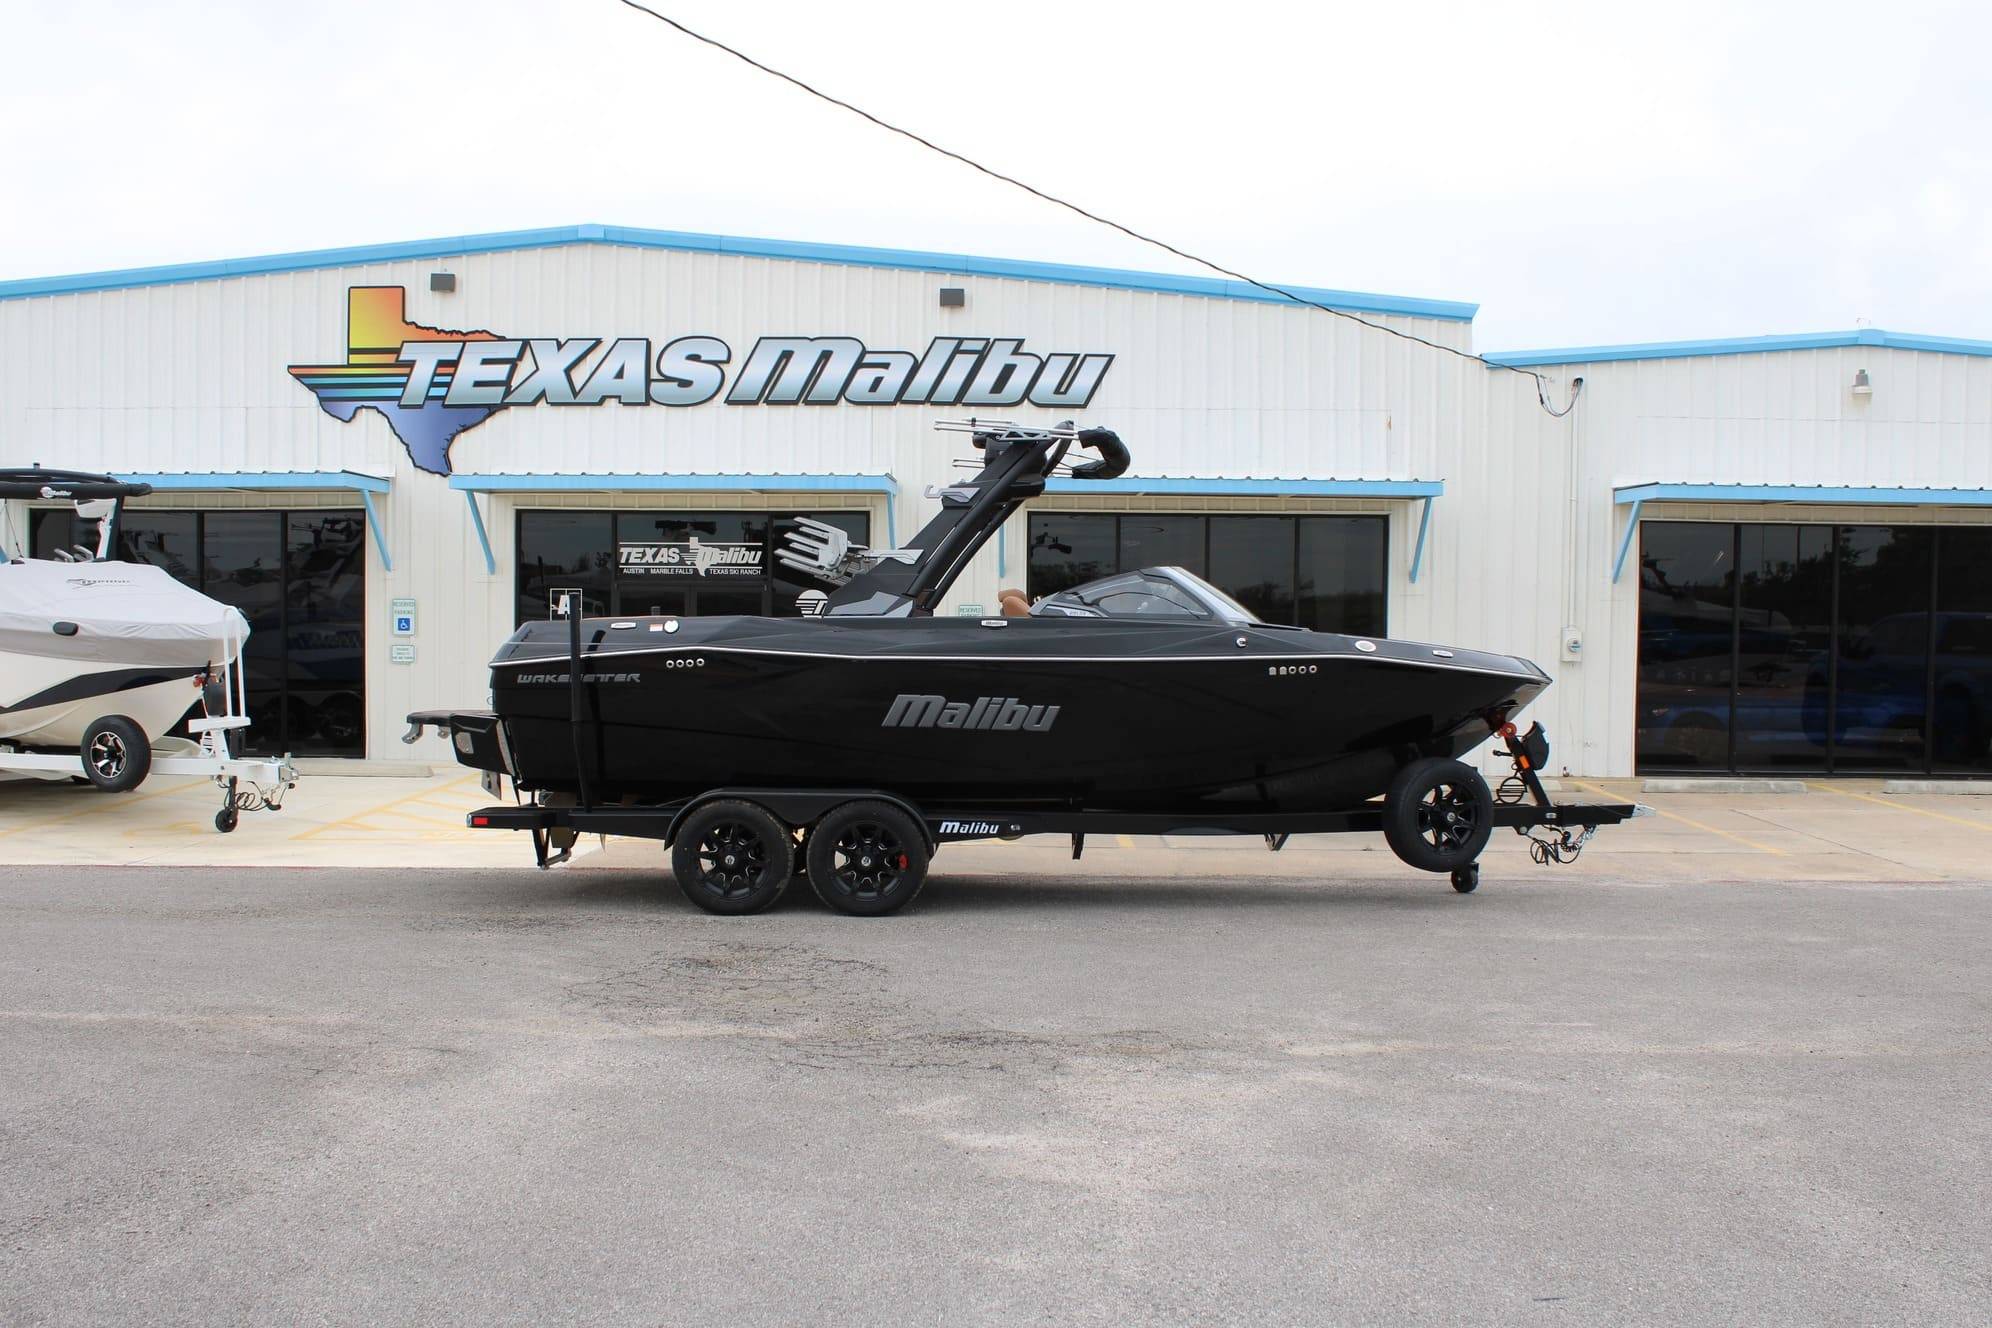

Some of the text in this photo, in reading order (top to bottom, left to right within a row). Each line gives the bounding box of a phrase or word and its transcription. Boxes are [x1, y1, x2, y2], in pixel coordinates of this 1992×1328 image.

[397, 335, 1116, 408] TEXAS Malibu
[619, 547, 762, 564] TEXAS Malibu
[517, 673, 641, 684] WAKEETTER
[881, 694, 1061, 732] Malibu
[939, 821, 999, 834] Malibu
